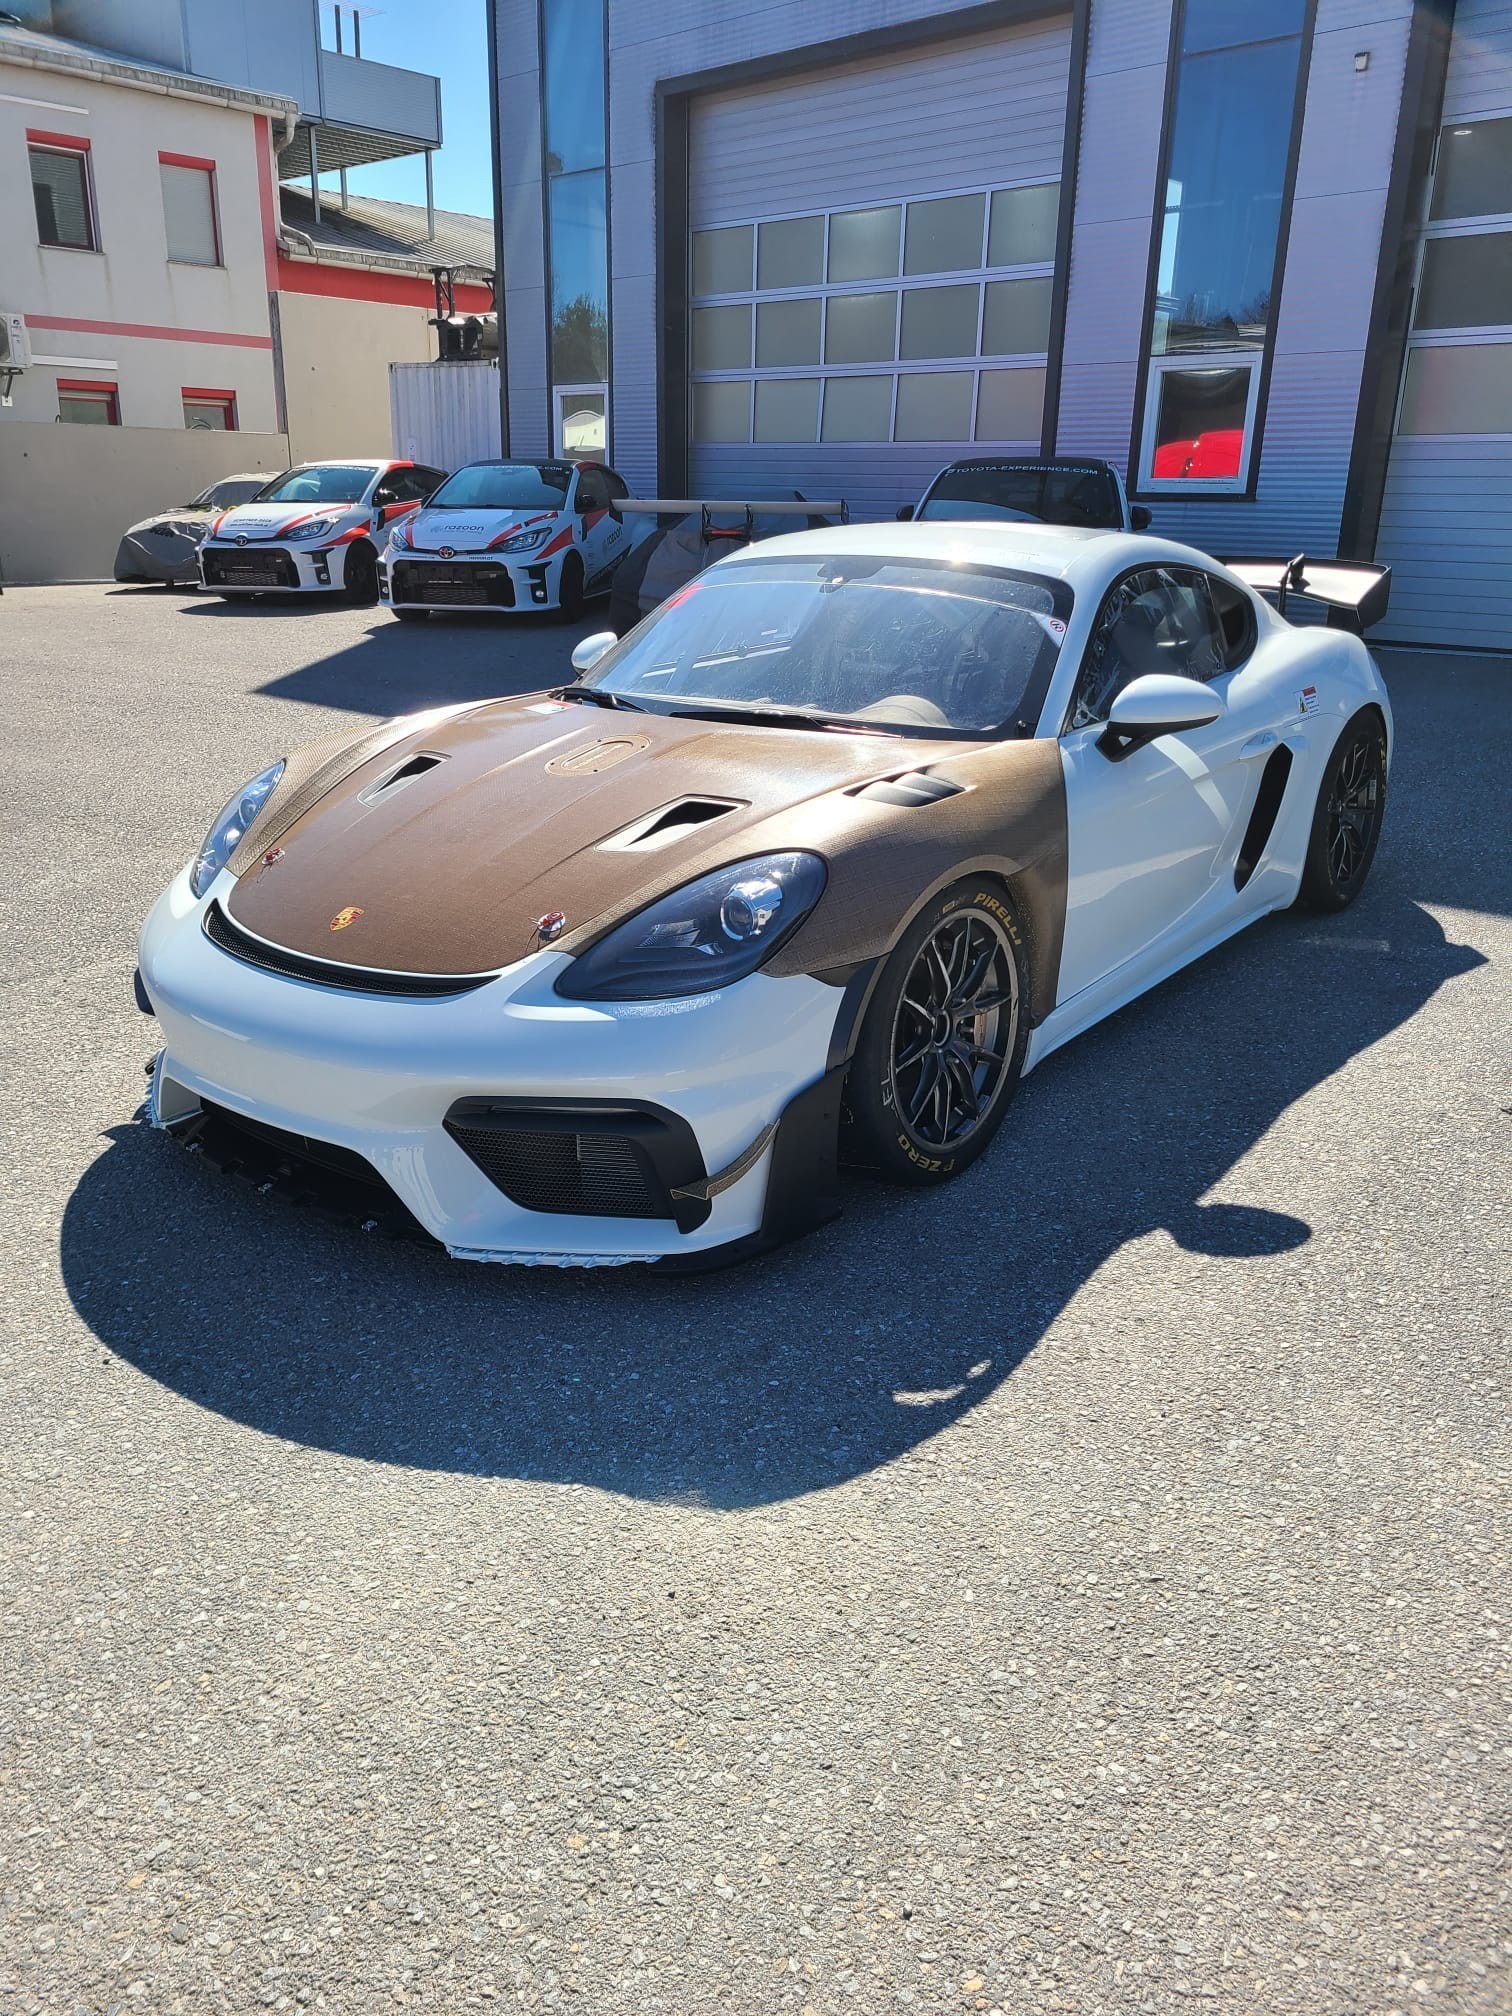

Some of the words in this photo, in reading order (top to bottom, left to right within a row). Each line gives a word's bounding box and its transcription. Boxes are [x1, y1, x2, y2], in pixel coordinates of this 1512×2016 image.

[956, 465, 1098, 475] TOYOTA-EXPERIENCE.COM
[974, 892, 1022, 945] PIRELLI
[898, 1134, 942, 1173] ZERO
